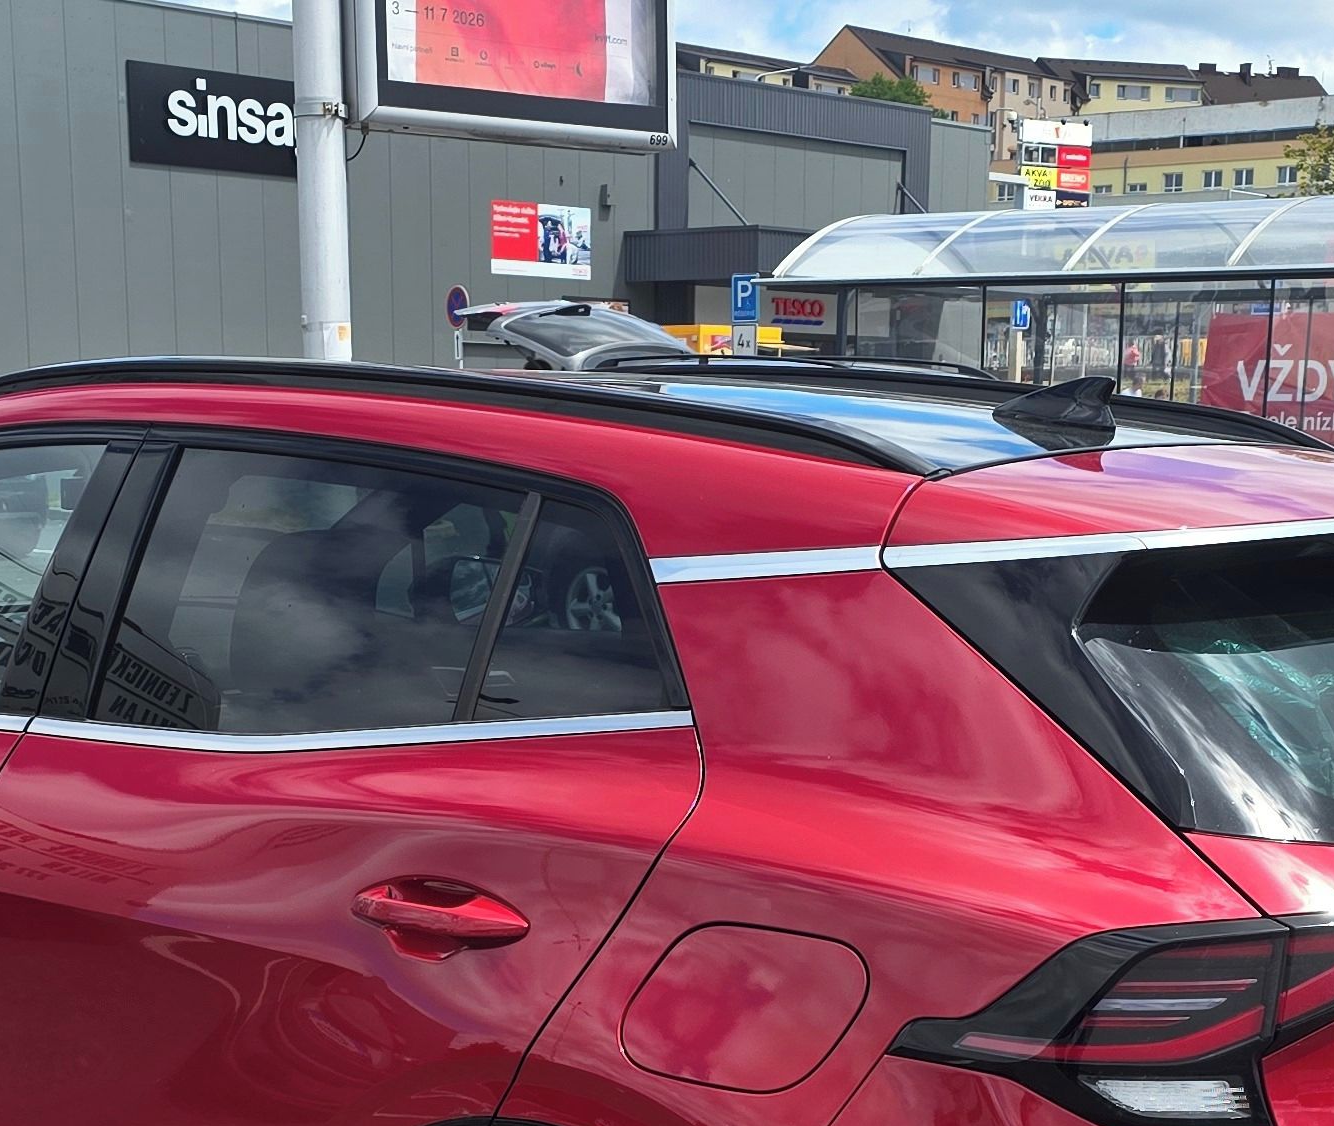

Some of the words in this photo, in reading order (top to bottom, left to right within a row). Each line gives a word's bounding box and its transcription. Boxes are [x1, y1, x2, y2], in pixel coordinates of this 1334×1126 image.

[391, 1, 400, 15] 3
[424, 6, 435, 20] 11
[440, 8, 447, 21] 7
[453, 10, 485, 27] 2026
[167, 77, 298, 156] sinsa
[649, 135, 668, 146] 699
[737, 280, 753, 308] P
[771, 297, 825, 318] TESCO
